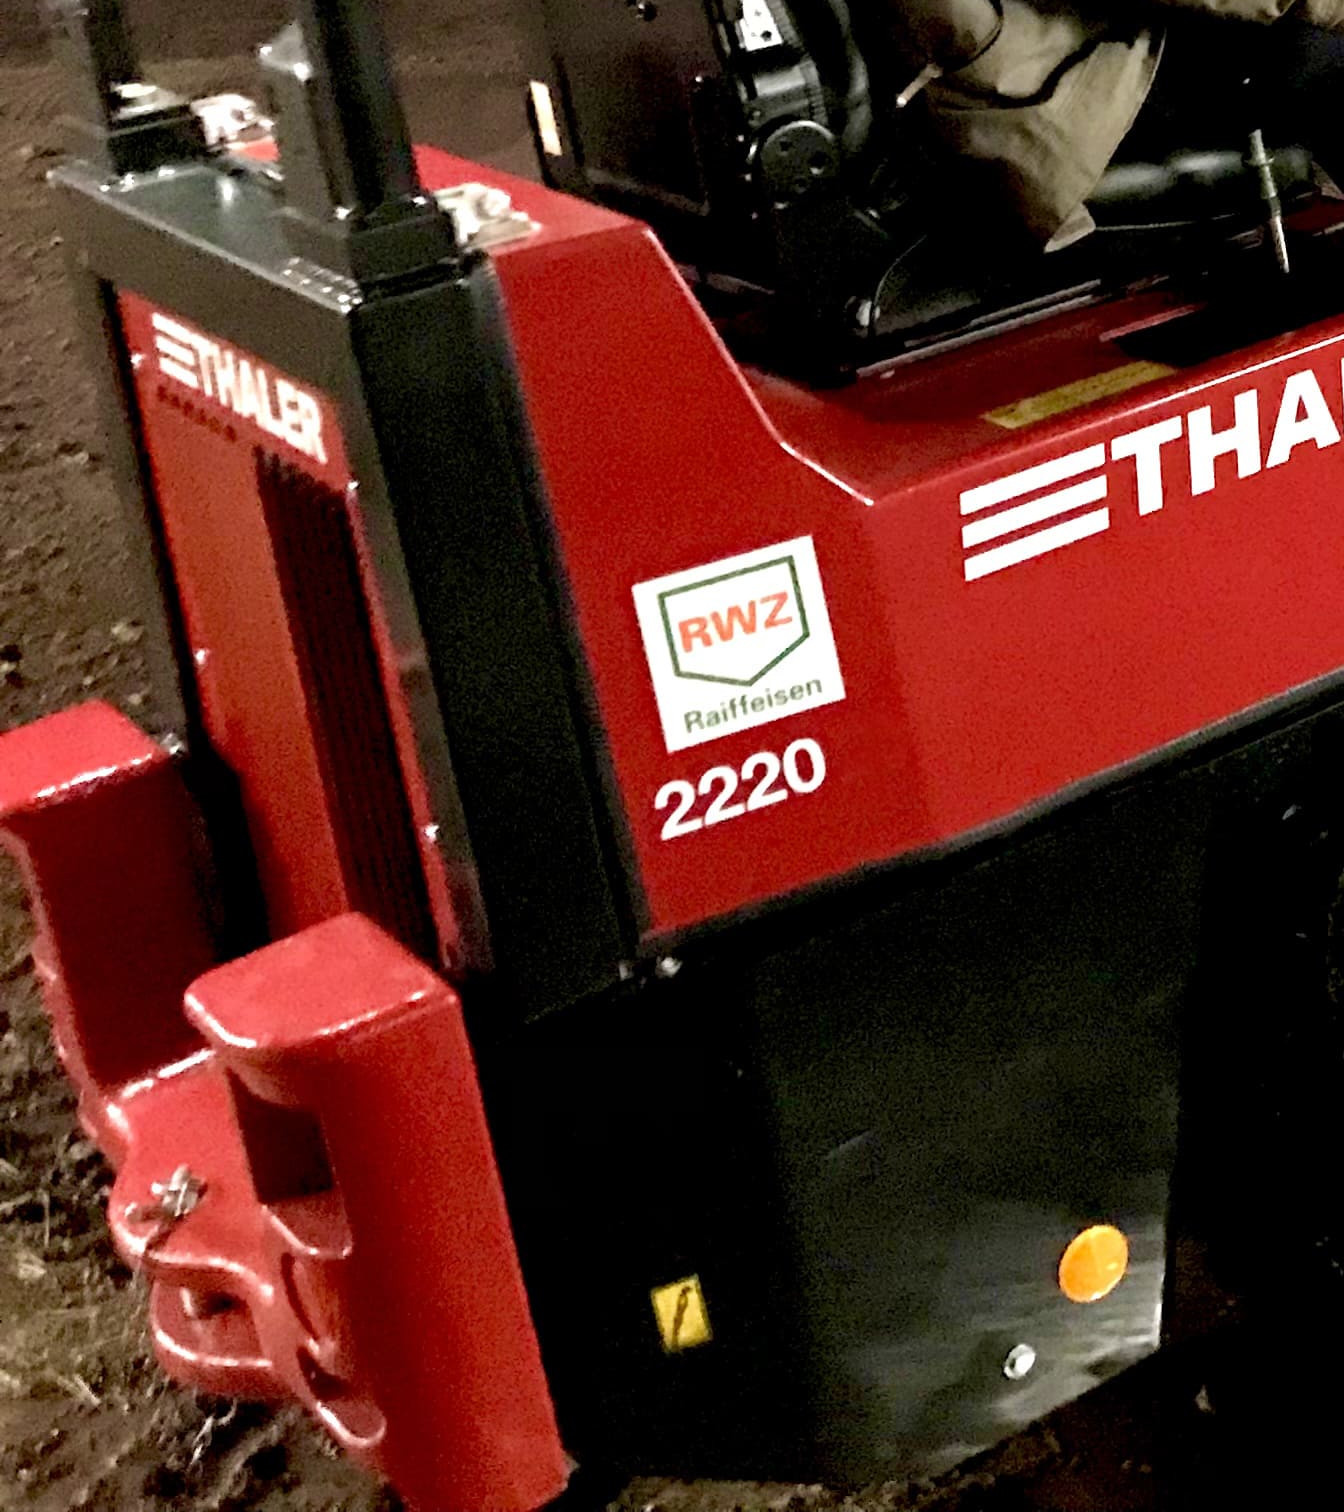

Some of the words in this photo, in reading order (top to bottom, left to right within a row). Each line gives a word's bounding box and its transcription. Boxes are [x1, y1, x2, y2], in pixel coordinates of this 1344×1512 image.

[195, 334, 328, 465] THALER
[678, 592, 793, 653] RWZ
[684, 679, 823, 734] Raiffeisen
[654, 738, 827, 841] 2220
